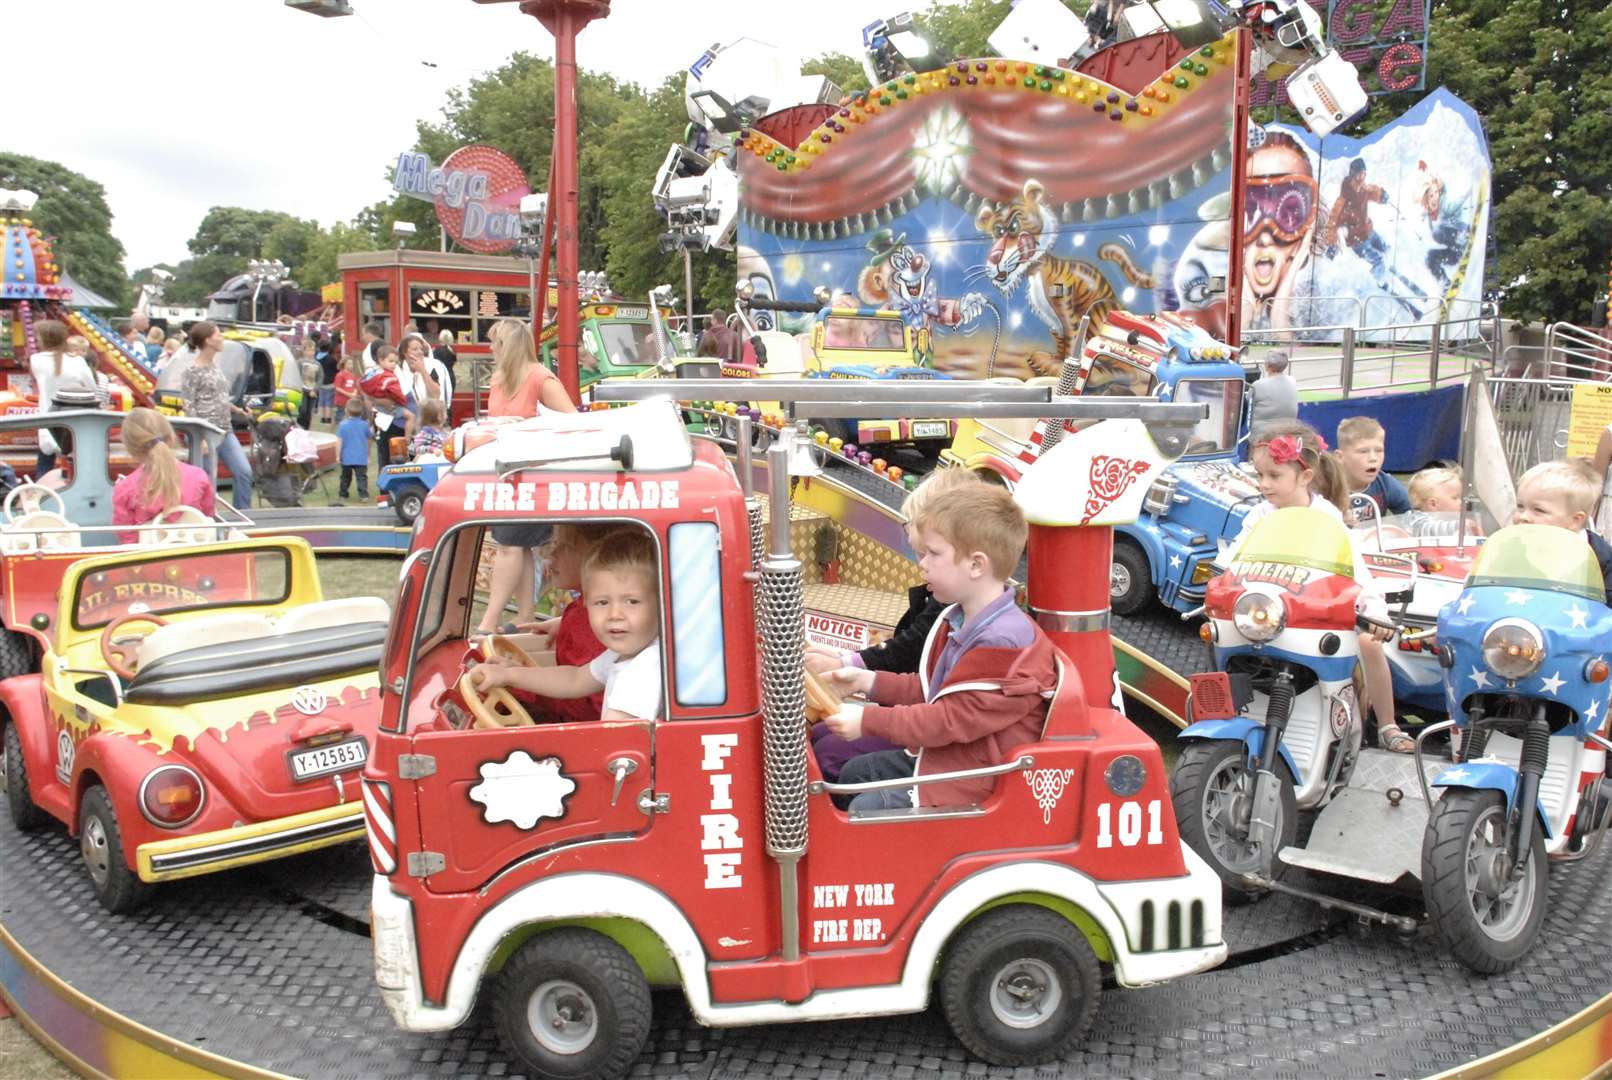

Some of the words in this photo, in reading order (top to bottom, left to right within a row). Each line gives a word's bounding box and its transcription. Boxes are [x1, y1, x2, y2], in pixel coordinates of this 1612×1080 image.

[394, 151, 489, 208] Mega
[416, 290, 436, 308] PAY
[438, 289, 464, 309] HERE
[722, 367, 752, 378] COLORS
[464, 482, 536, 511] FIRE
[547, 480, 680, 511] BRIGADE
[808, 616, 864, 640] NOTICE
[297, 743, 364, 772] Y-125851
[701, 733, 744, 889] FIRE
[1097, 800, 1163, 848] 101
[813, 884, 849, 908] NEW
[854, 883, 895, 907] YORK
[813, 919, 848, 943] FIRE
[853, 918, 886, 941] DEP.
